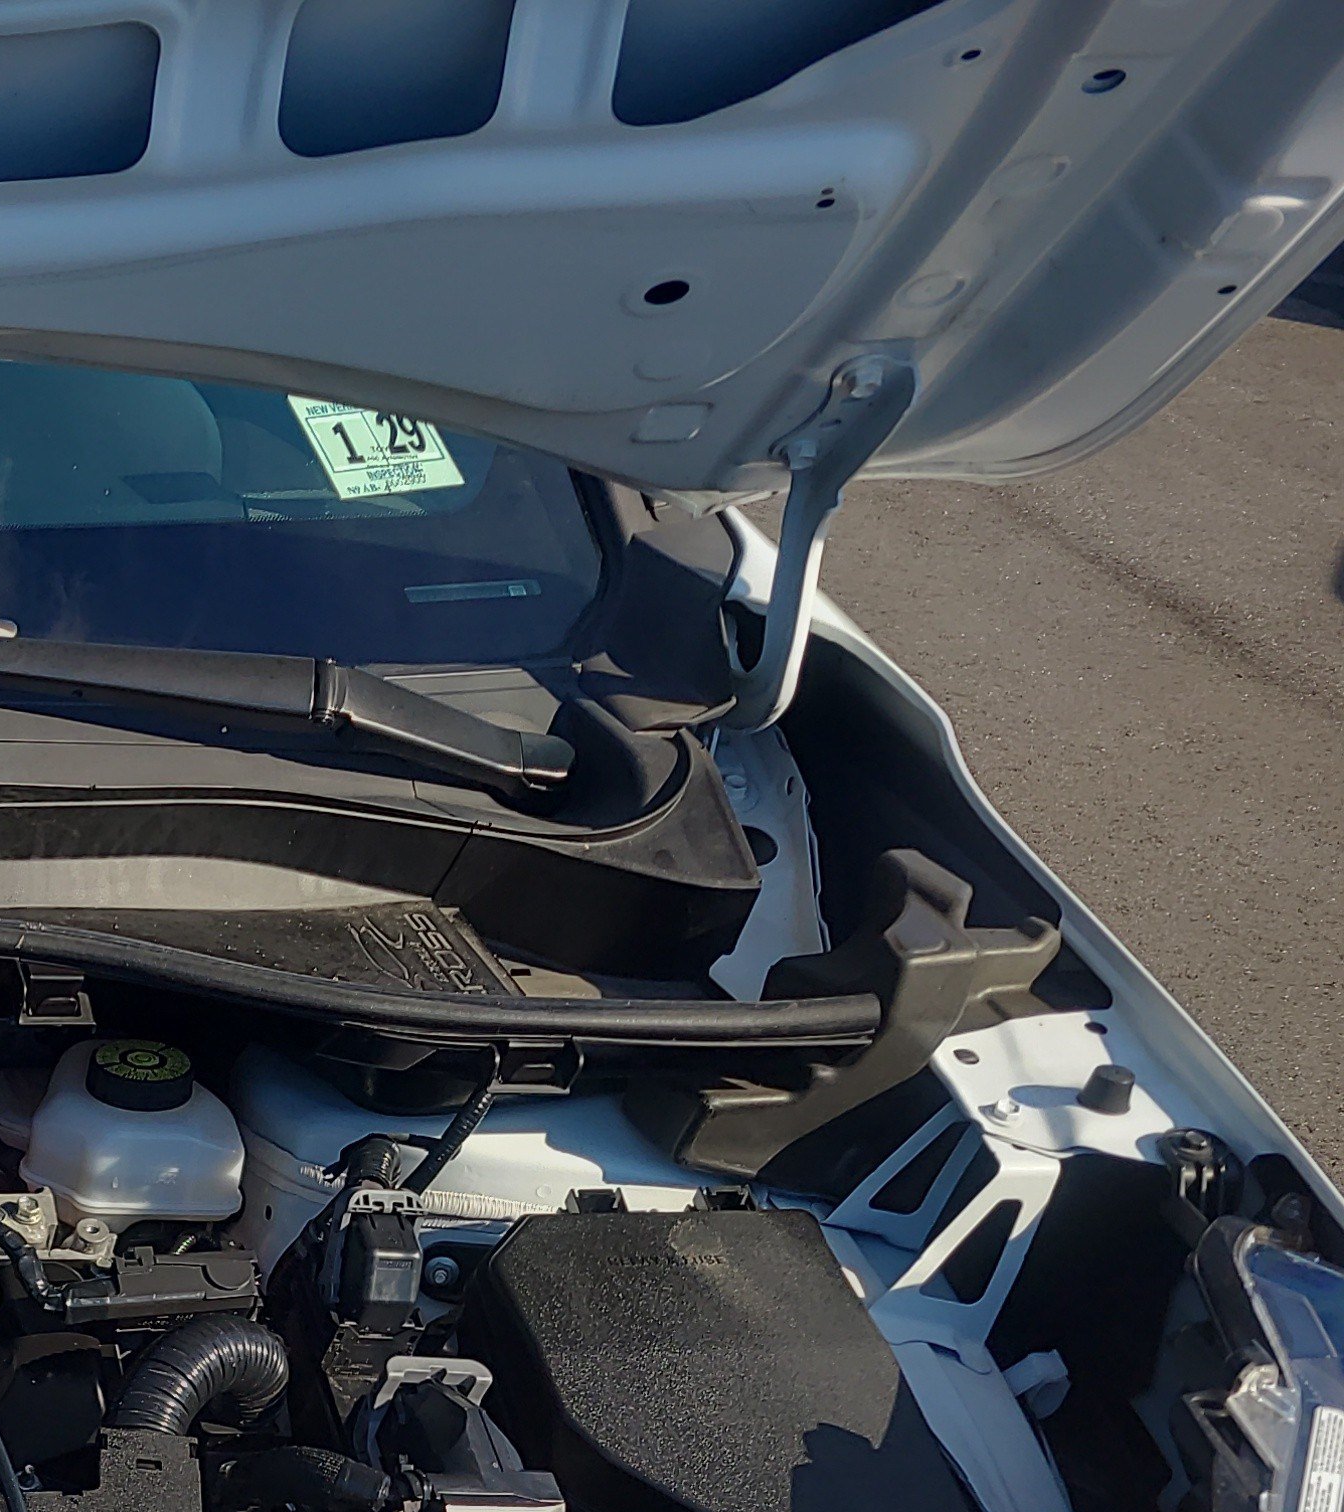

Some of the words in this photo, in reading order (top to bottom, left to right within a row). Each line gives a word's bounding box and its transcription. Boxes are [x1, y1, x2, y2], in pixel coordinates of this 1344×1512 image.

[306, 405, 329, 416] NEW
[332, 421, 366, 464] 1
[375, 411, 426, 454] 29
[404, 913, 487, 994] ROSS
